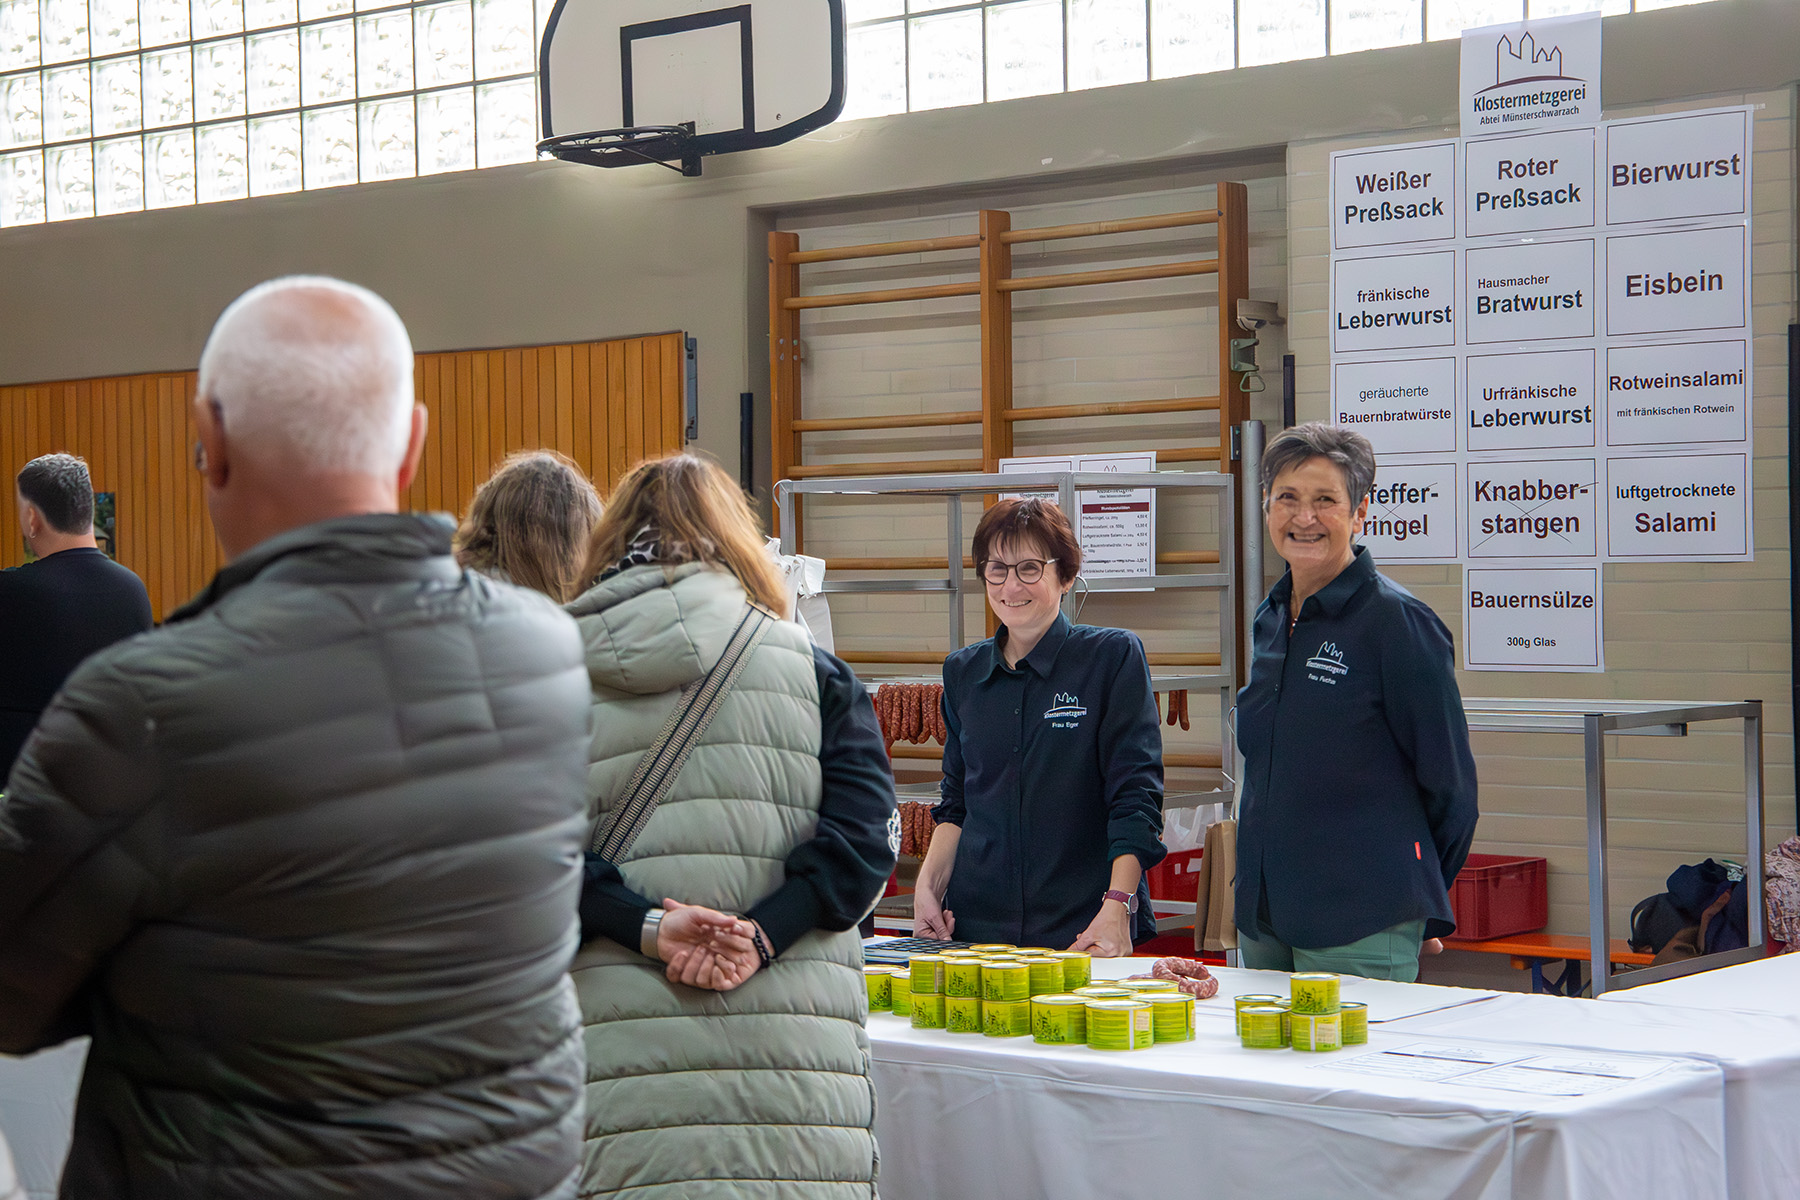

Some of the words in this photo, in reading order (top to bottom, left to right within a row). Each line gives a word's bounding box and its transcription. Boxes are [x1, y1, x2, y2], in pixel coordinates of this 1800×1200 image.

[1473, 84, 1586, 113] Klostermetzgerei
[1480, 115, 1500, 125] Abtei
[1502, 105, 1580, 123] Münsterschwarzach
[1498, 157, 1559, 181] Roter
[1612, 153, 1741, 187] Bierwurst
[1355, 170, 1432, 195] Weißer
[1476, 182, 1581, 212] Preßsack
[1345, 196, 1444, 225] Preßsack
[1477, 274, 1550, 289] Hausmacher
[1626, 269, 1723, 298] Eisbein
[1357, 286, 1430, 303] fränkische
[1477, 289, 1583, 315] Bratwurst
[1337, 305, 1452, 330] Leberwurst
[1609, 368, 1743, 392] Rotweinsalami
[1359, 385, 1429, 403] geräucherte
[1483, 384, 1577, 401] Urfränkische
[1339, 408, 1452, 424] Bauernbratwürste
[1470, 405, 1592, 428] Leberwurst
[1616, 408, 1632, 418] mit
[1633, 405, 1691, 417] fränkischen
[1693, 404, 1735, 414] Rotwein
[1369, 483, 1439, 504] feffer-
[1475, 479, 1589, 502] Knabber-
[1616, 483, 1736, 502] luftgetrocknete
[1363, 514, 1428, 541] ringel
[1481, 513, 1580, 539] stangen
[1635, 511, 1716, 533] Salami
[1470, 590, 1594, 609] Bauernsülze
[1506, 636, 1531, 649] 300g
[1533, 636, 1557, 647] Glas
